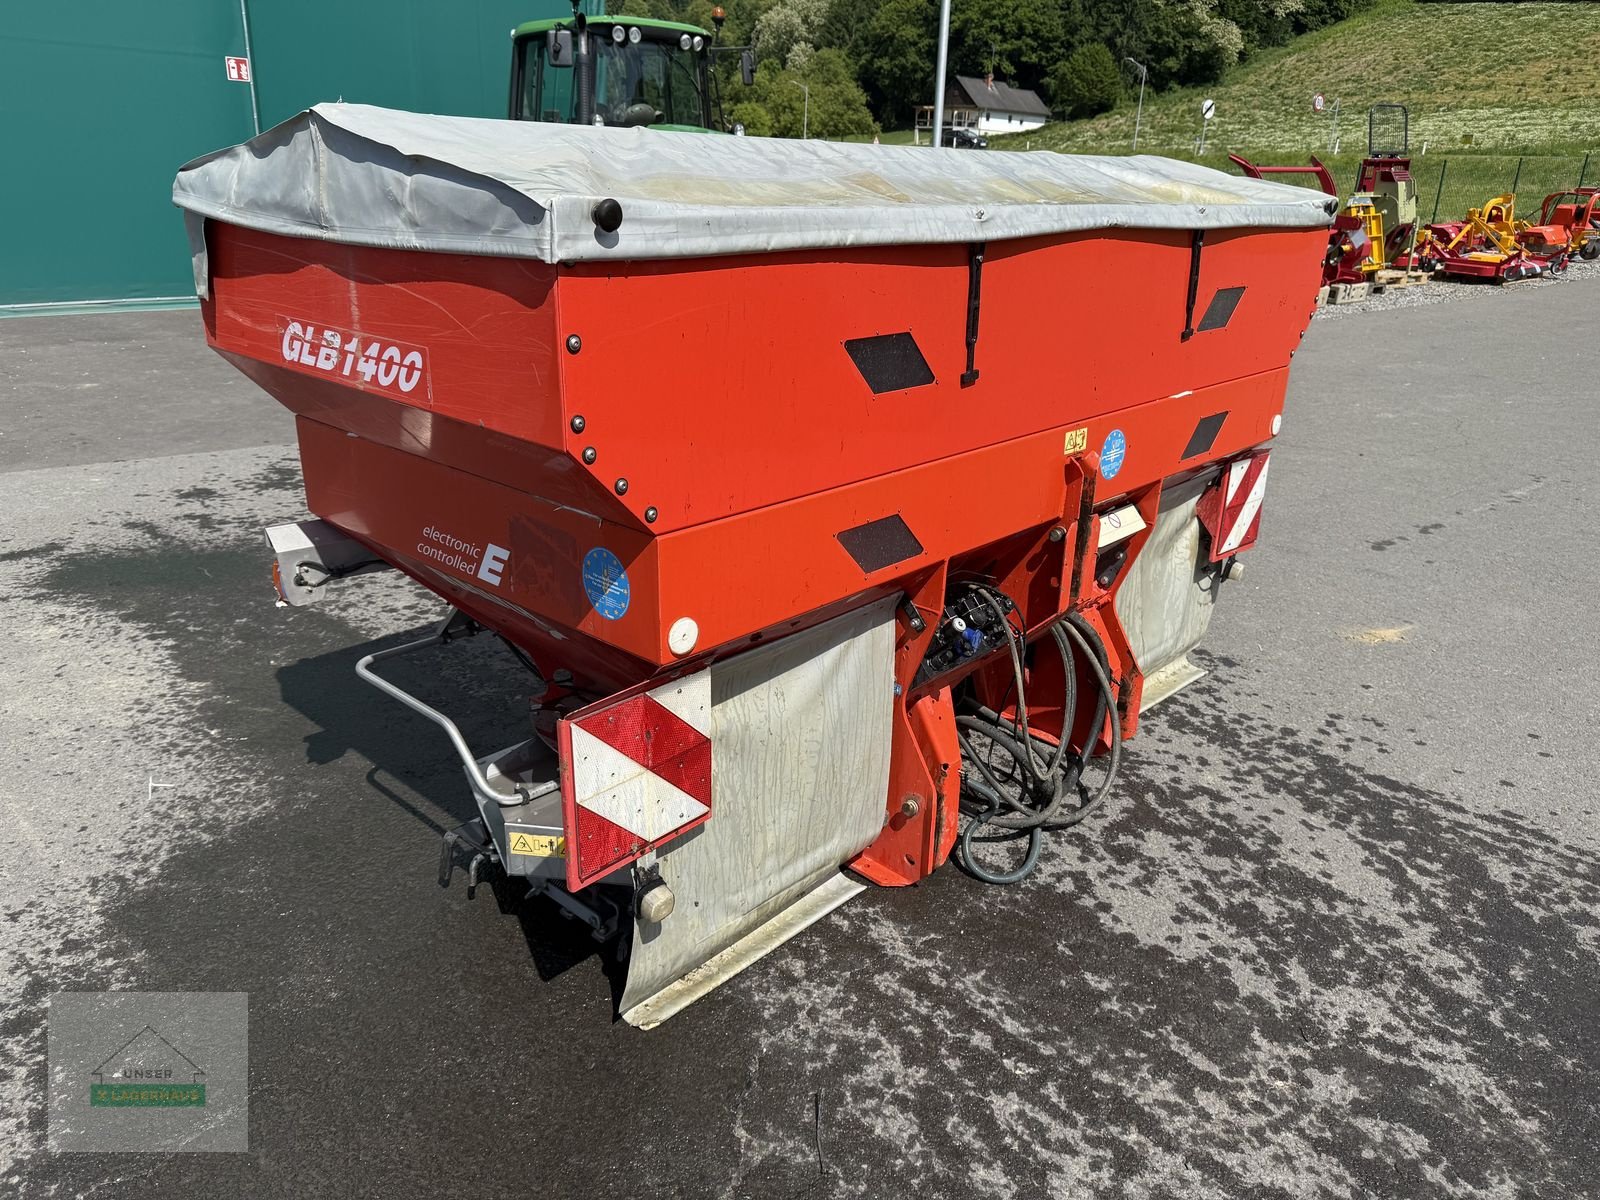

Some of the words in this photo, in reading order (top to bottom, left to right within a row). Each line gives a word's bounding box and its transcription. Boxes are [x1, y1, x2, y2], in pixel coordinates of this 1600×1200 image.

[416, 541, 477, 576] controlled
[422, 525, 481, 559] electronic
[477, 543, 511, 587] E
